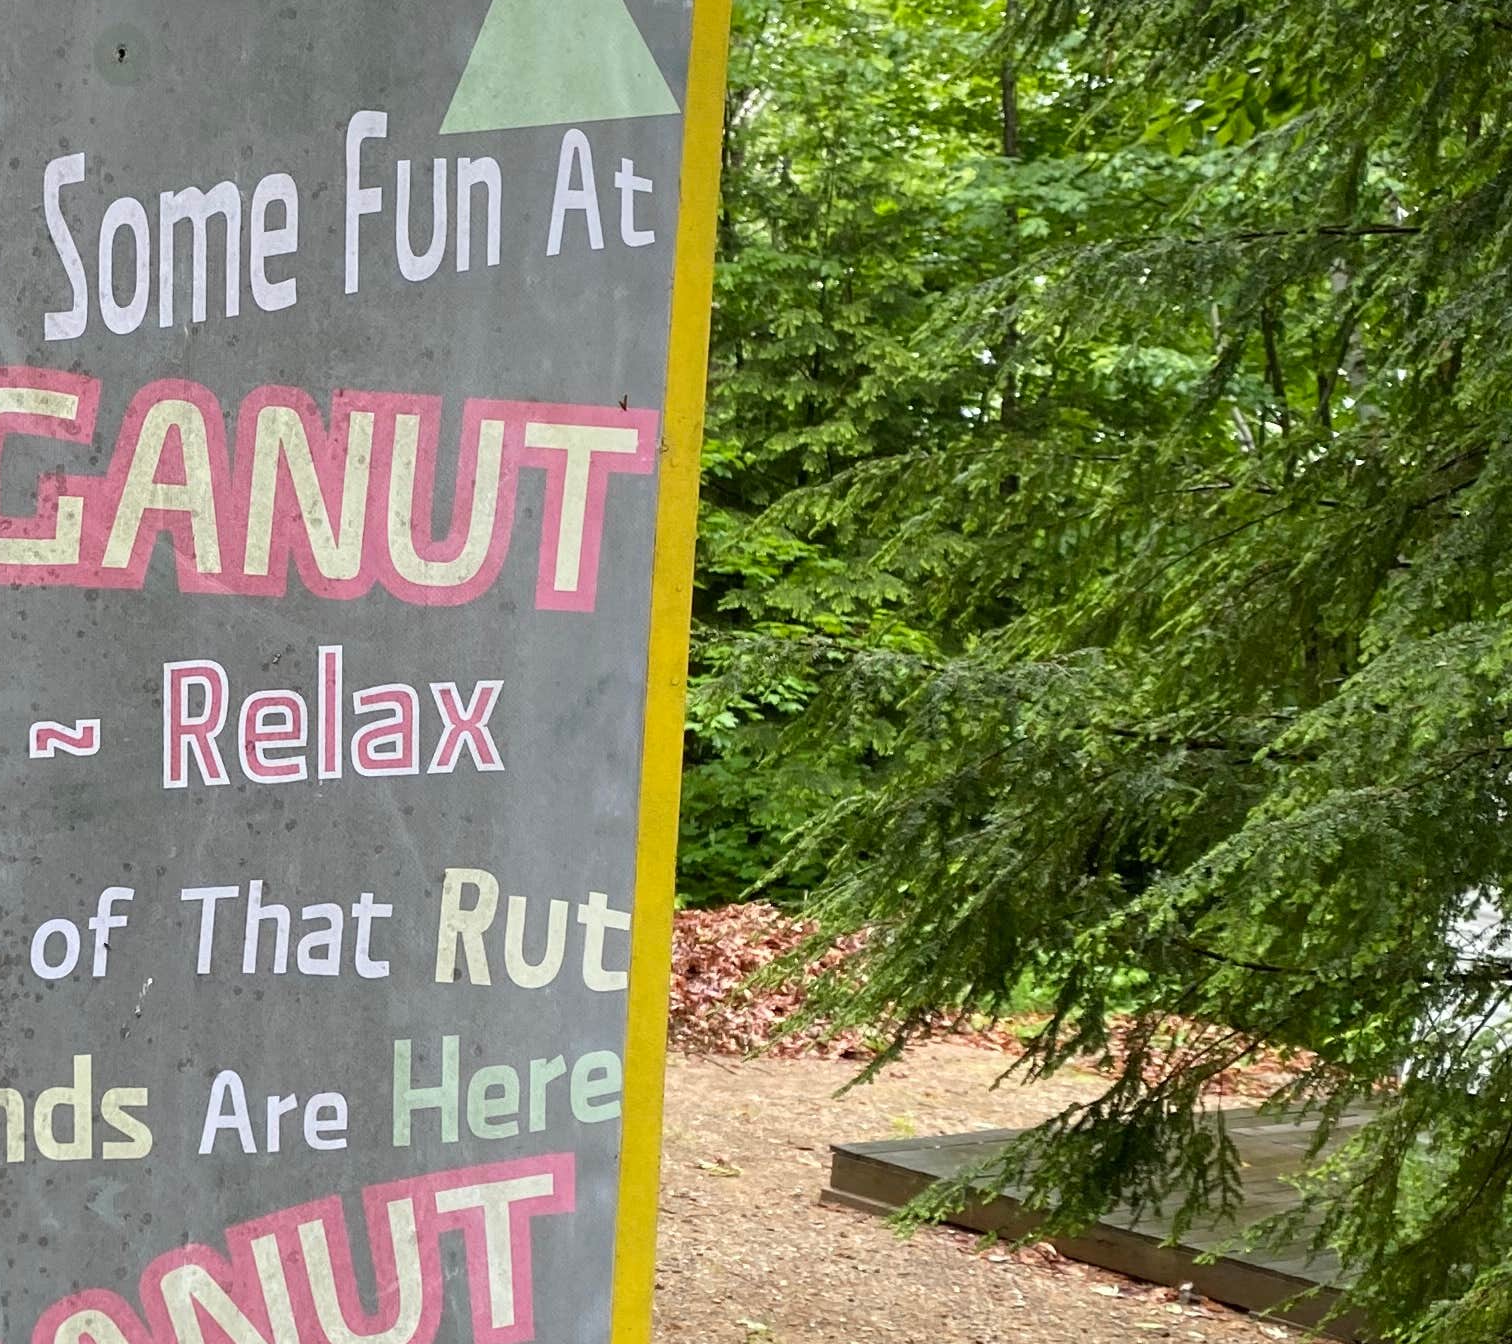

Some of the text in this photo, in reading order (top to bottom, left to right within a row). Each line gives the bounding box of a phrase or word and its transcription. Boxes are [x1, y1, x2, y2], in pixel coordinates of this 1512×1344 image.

[43, 152, 299, 342] Some
[345, 110, 502, 295] Fun
[547, 128, 656, 256] At
[163, 645, 505, 789] Relax
[30, 887, 135, 980] of
[180, 879, 393, 979] That
[435, 868, 632, 992] Rut
[198, 1069, 348, 1155] Are
[393, 1035, 623, 1148] Here
